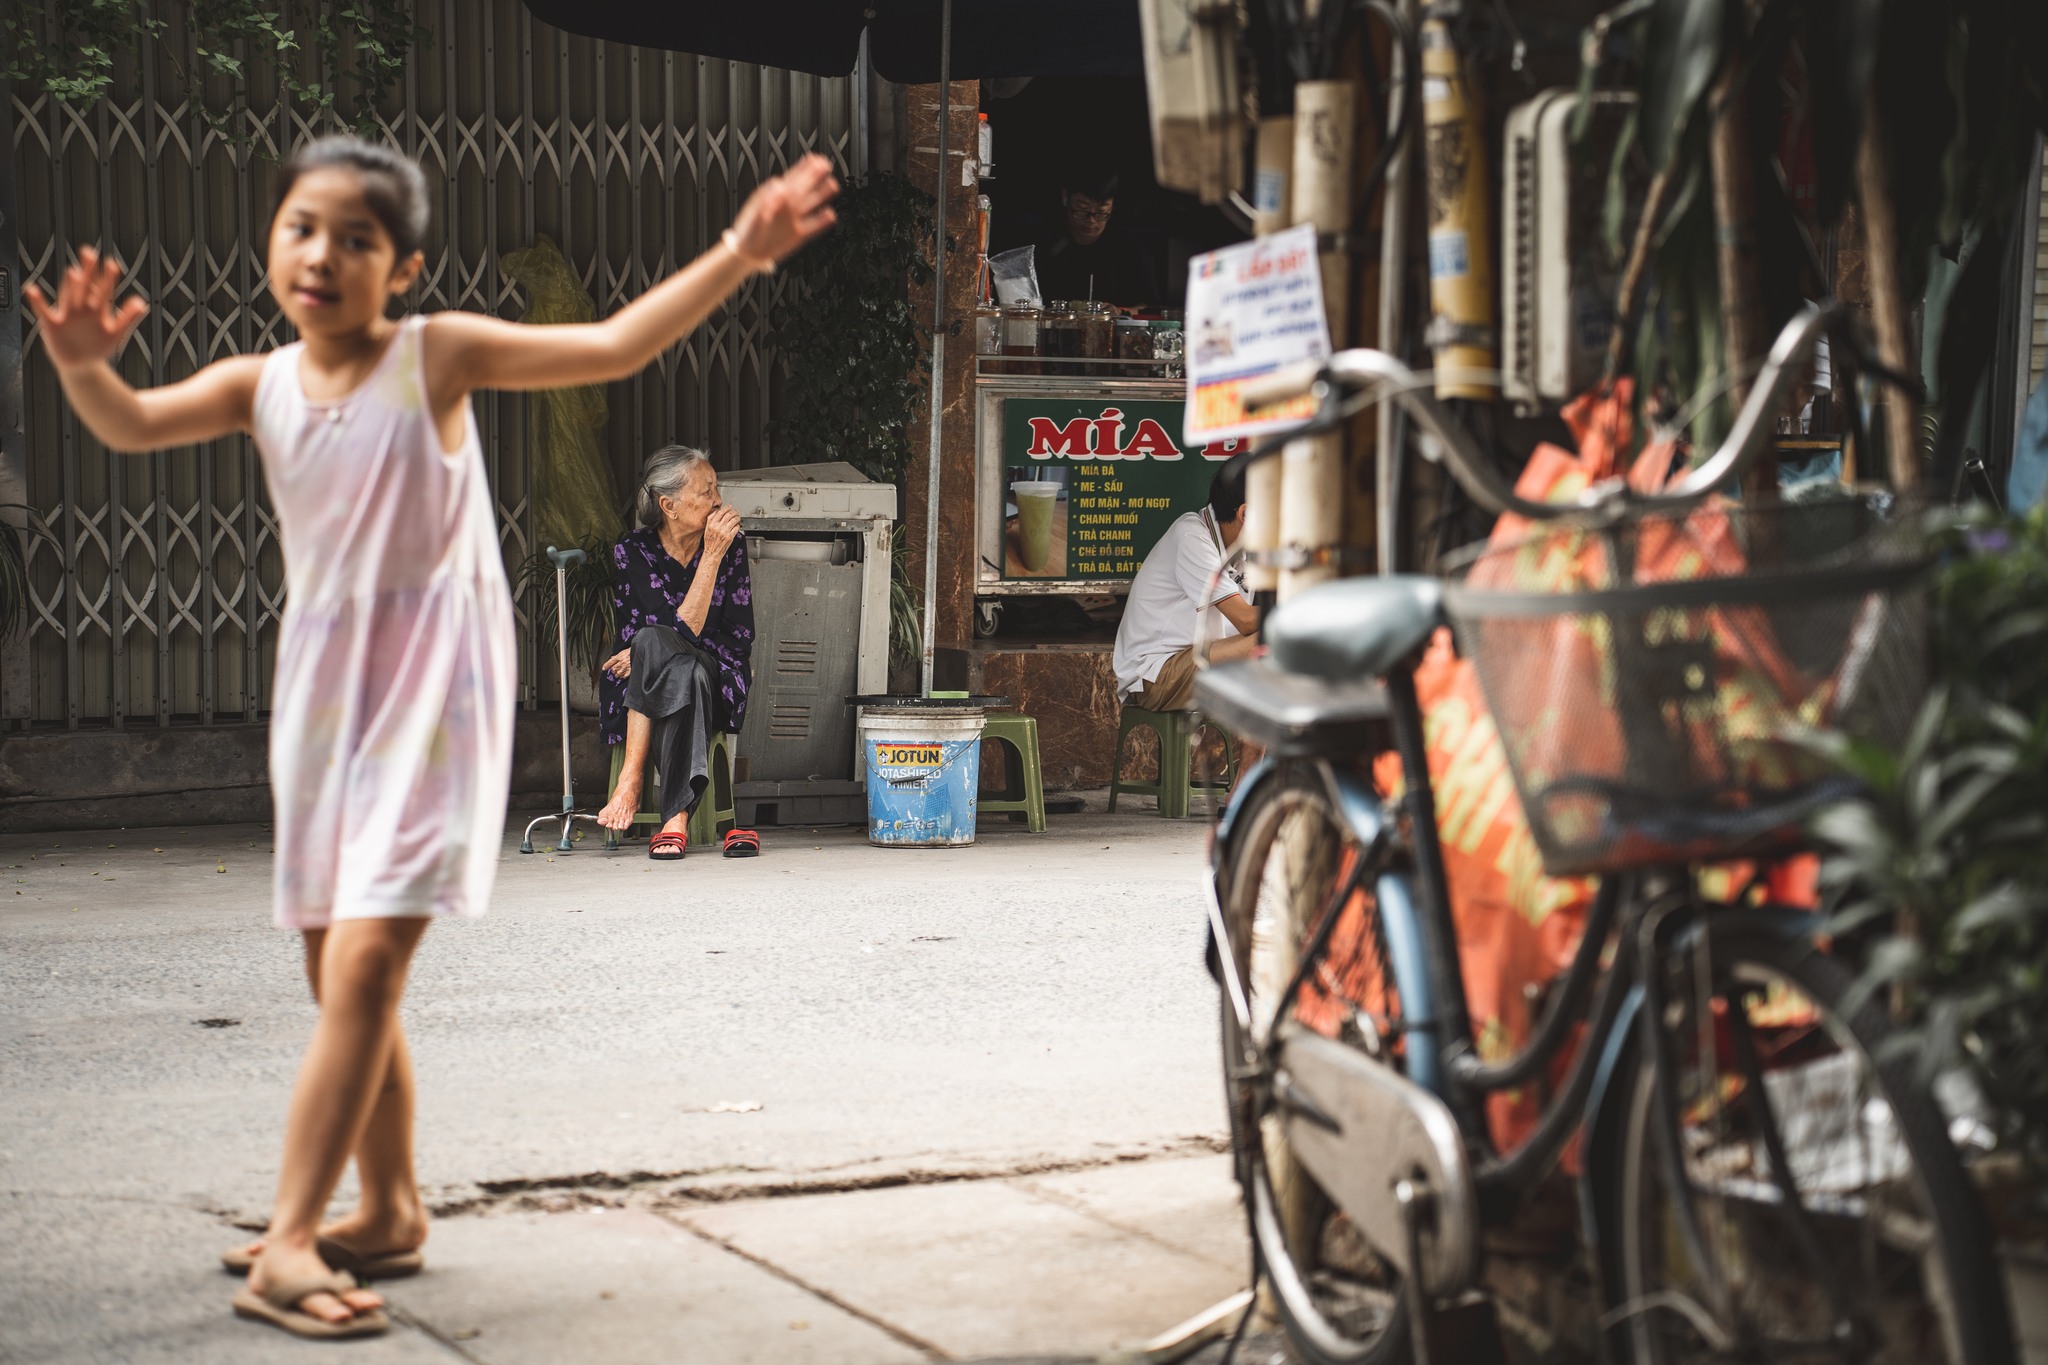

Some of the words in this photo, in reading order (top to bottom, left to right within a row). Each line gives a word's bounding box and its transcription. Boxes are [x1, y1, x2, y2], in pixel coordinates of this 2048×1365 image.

[1027, 407, 1184, 461] MÍA
[1081, 464, 1099, 476] MÍA
[1101, 464, 1115, 476] ĐÁ
[1080, 482, 1095, 492] ME
[1104, 479, 1123, 492] SẤU
[1080, 498, 1096, 508] MƠ
[1097, 496, 1120, 510] MẶN
[1128, 498, 1144, 508] MƠ
[1145, 498, 1171, 510] NGỌT
[1080, 514, 1112, 524] CHANH
[1113, 511, 1138, 524] MUỐI
[1079, 529, 1097, 540] TRÀ
[1099, 530, 1131, 540] CHANH
[1078, 545, 1097, 557] CHÈ
[1114, 546, 1134, 556] ĐEN
[1078, 561, 1096, 573] TRÀ
[1098, 561, 1114, 573] ĐÁ,
[1116, 561, 1134, 572] BÁT
[890, 750, 939, 763] JOTUN
